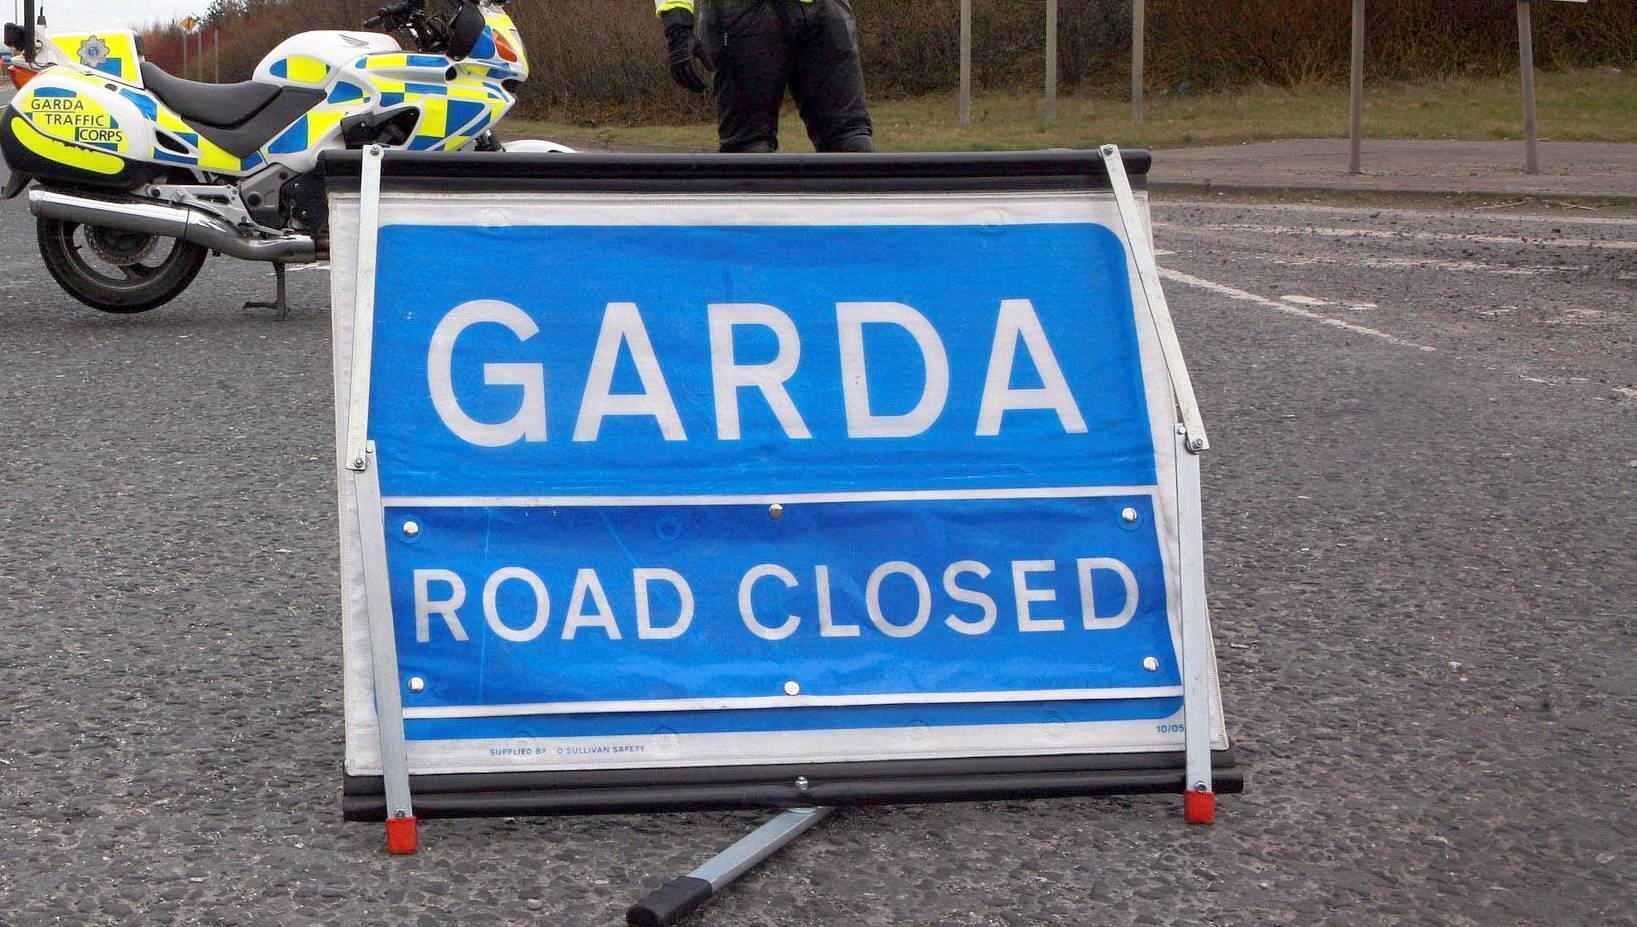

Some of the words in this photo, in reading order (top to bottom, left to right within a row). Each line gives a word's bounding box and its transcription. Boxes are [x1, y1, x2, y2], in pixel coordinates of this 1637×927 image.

[31, 98, 84, 110] GARDA
[45, 113, 104, 126] TRAFFIC
[79, 129, 123, 142] CORPS
[427, 299, 1089, 447] GARDA
[413, 566, 695, 643] ROAD
[738, 557, 1139, 641] CLOSED
[1156, 724, 1184, 733] 10/05
[490, 748, 533, 756] SUPPLIED
[566, 746, 610, 754] SULLIVAN
[613, 745, 645, 753] SAFETY
